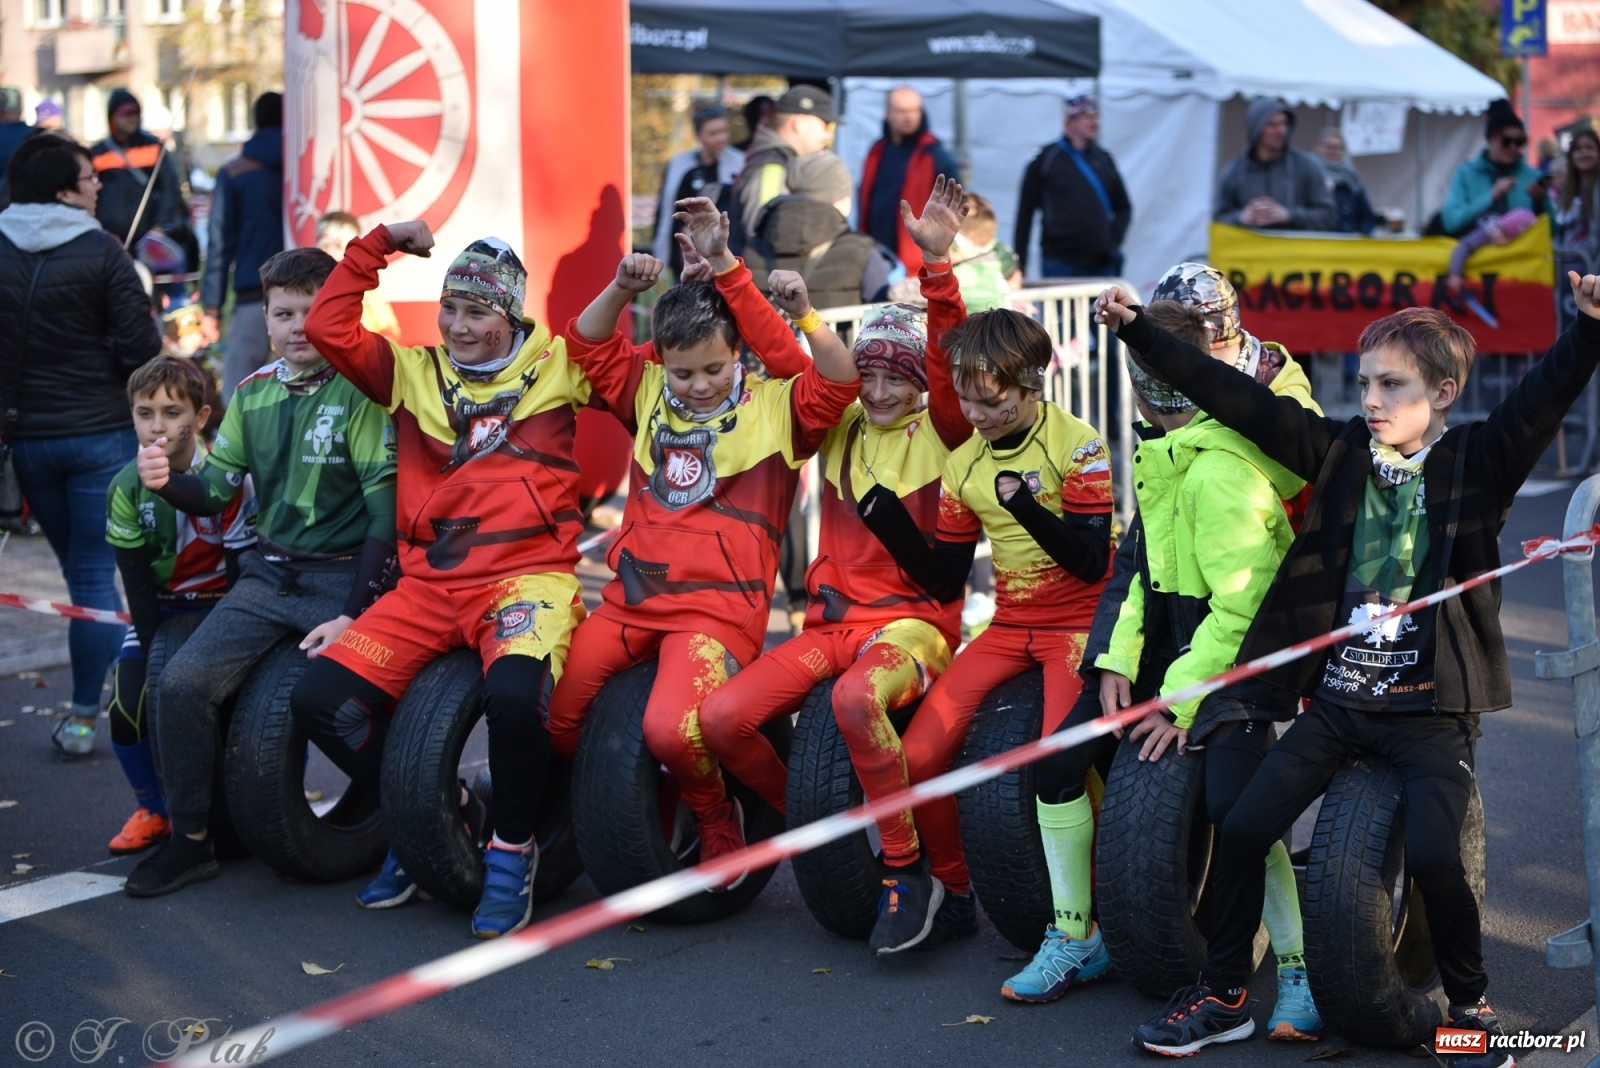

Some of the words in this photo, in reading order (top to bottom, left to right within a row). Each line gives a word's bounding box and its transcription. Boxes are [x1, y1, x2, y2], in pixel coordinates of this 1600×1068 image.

[485, 330, 500, 347] 28
[1000, 405, 1018, 425] 29
[668, 491, 688, 504] OCR
[1088, 515, 1105, 527] 4F
[334, 629, 394, 667] YMON
[1350, 650, 1411, 665] STOLLDREW
